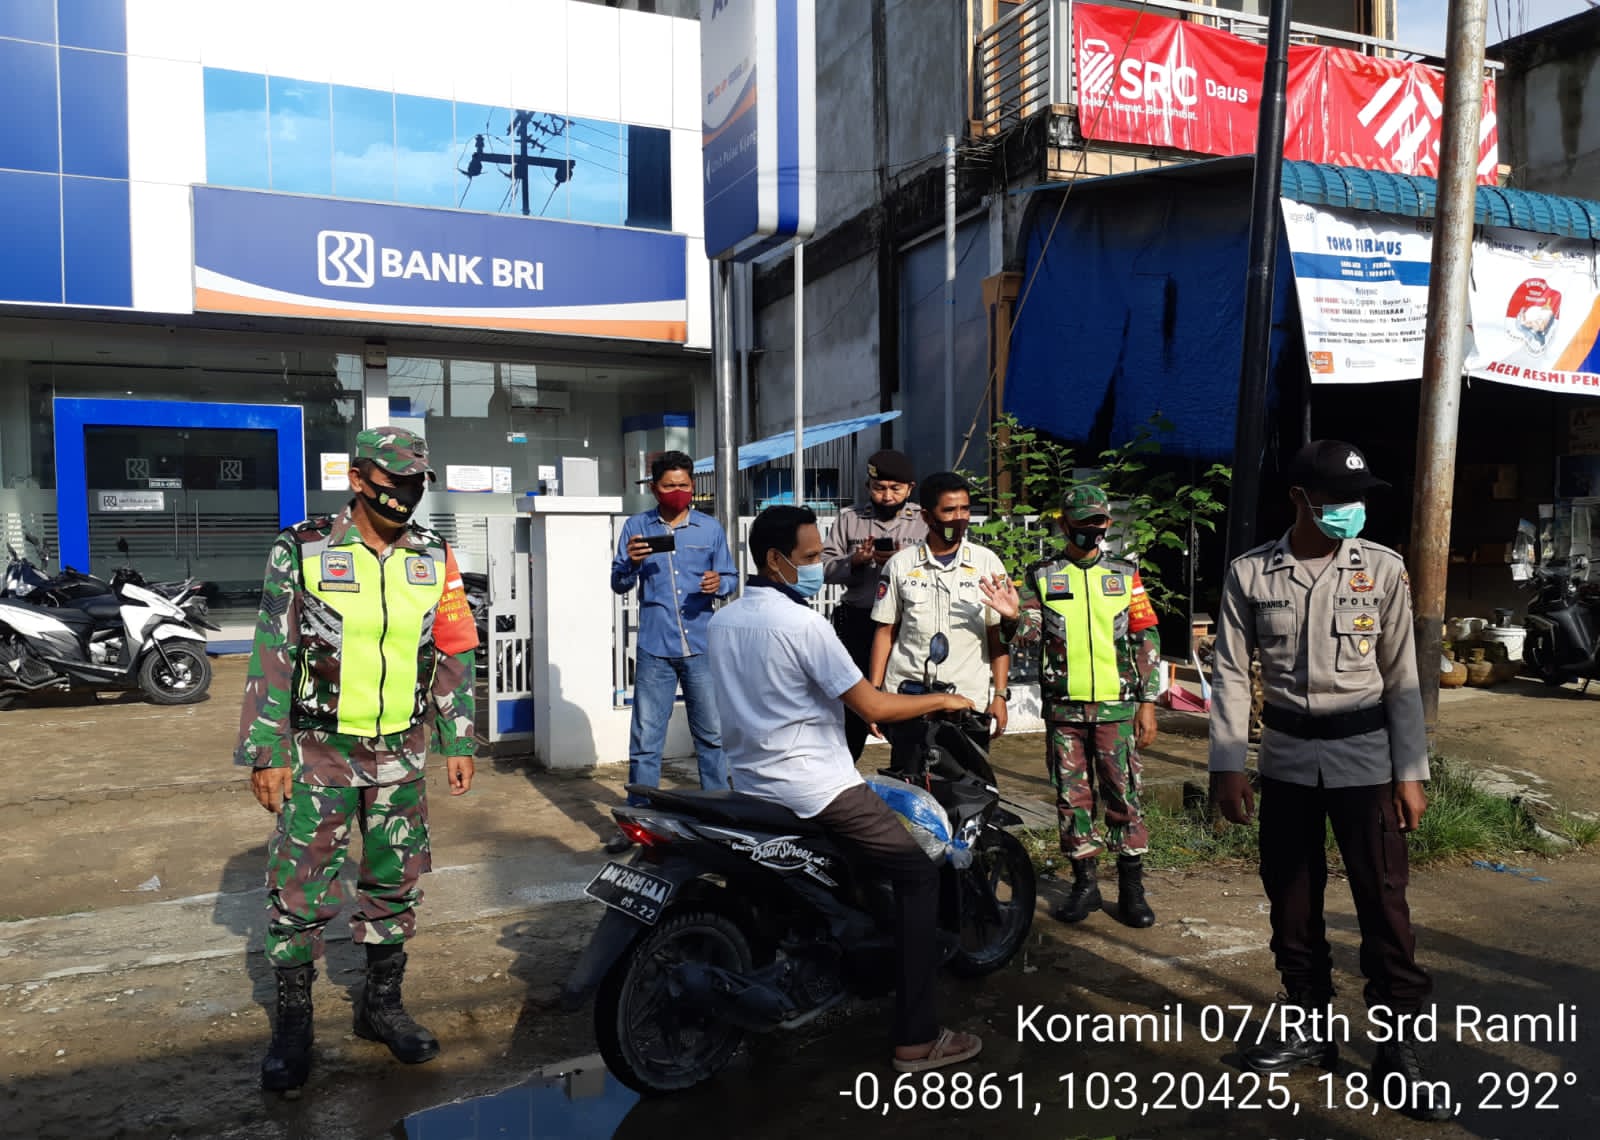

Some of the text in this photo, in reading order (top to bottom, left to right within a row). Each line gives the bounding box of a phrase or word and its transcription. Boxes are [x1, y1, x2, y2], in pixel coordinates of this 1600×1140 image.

[1119, 58, 1249, 105] SRC Daus
[381, 247, 544, 291] BANK BRI
[1487, 361, 1520, 377] AGEN
[1523, 368, 1566, 384] RESMI
